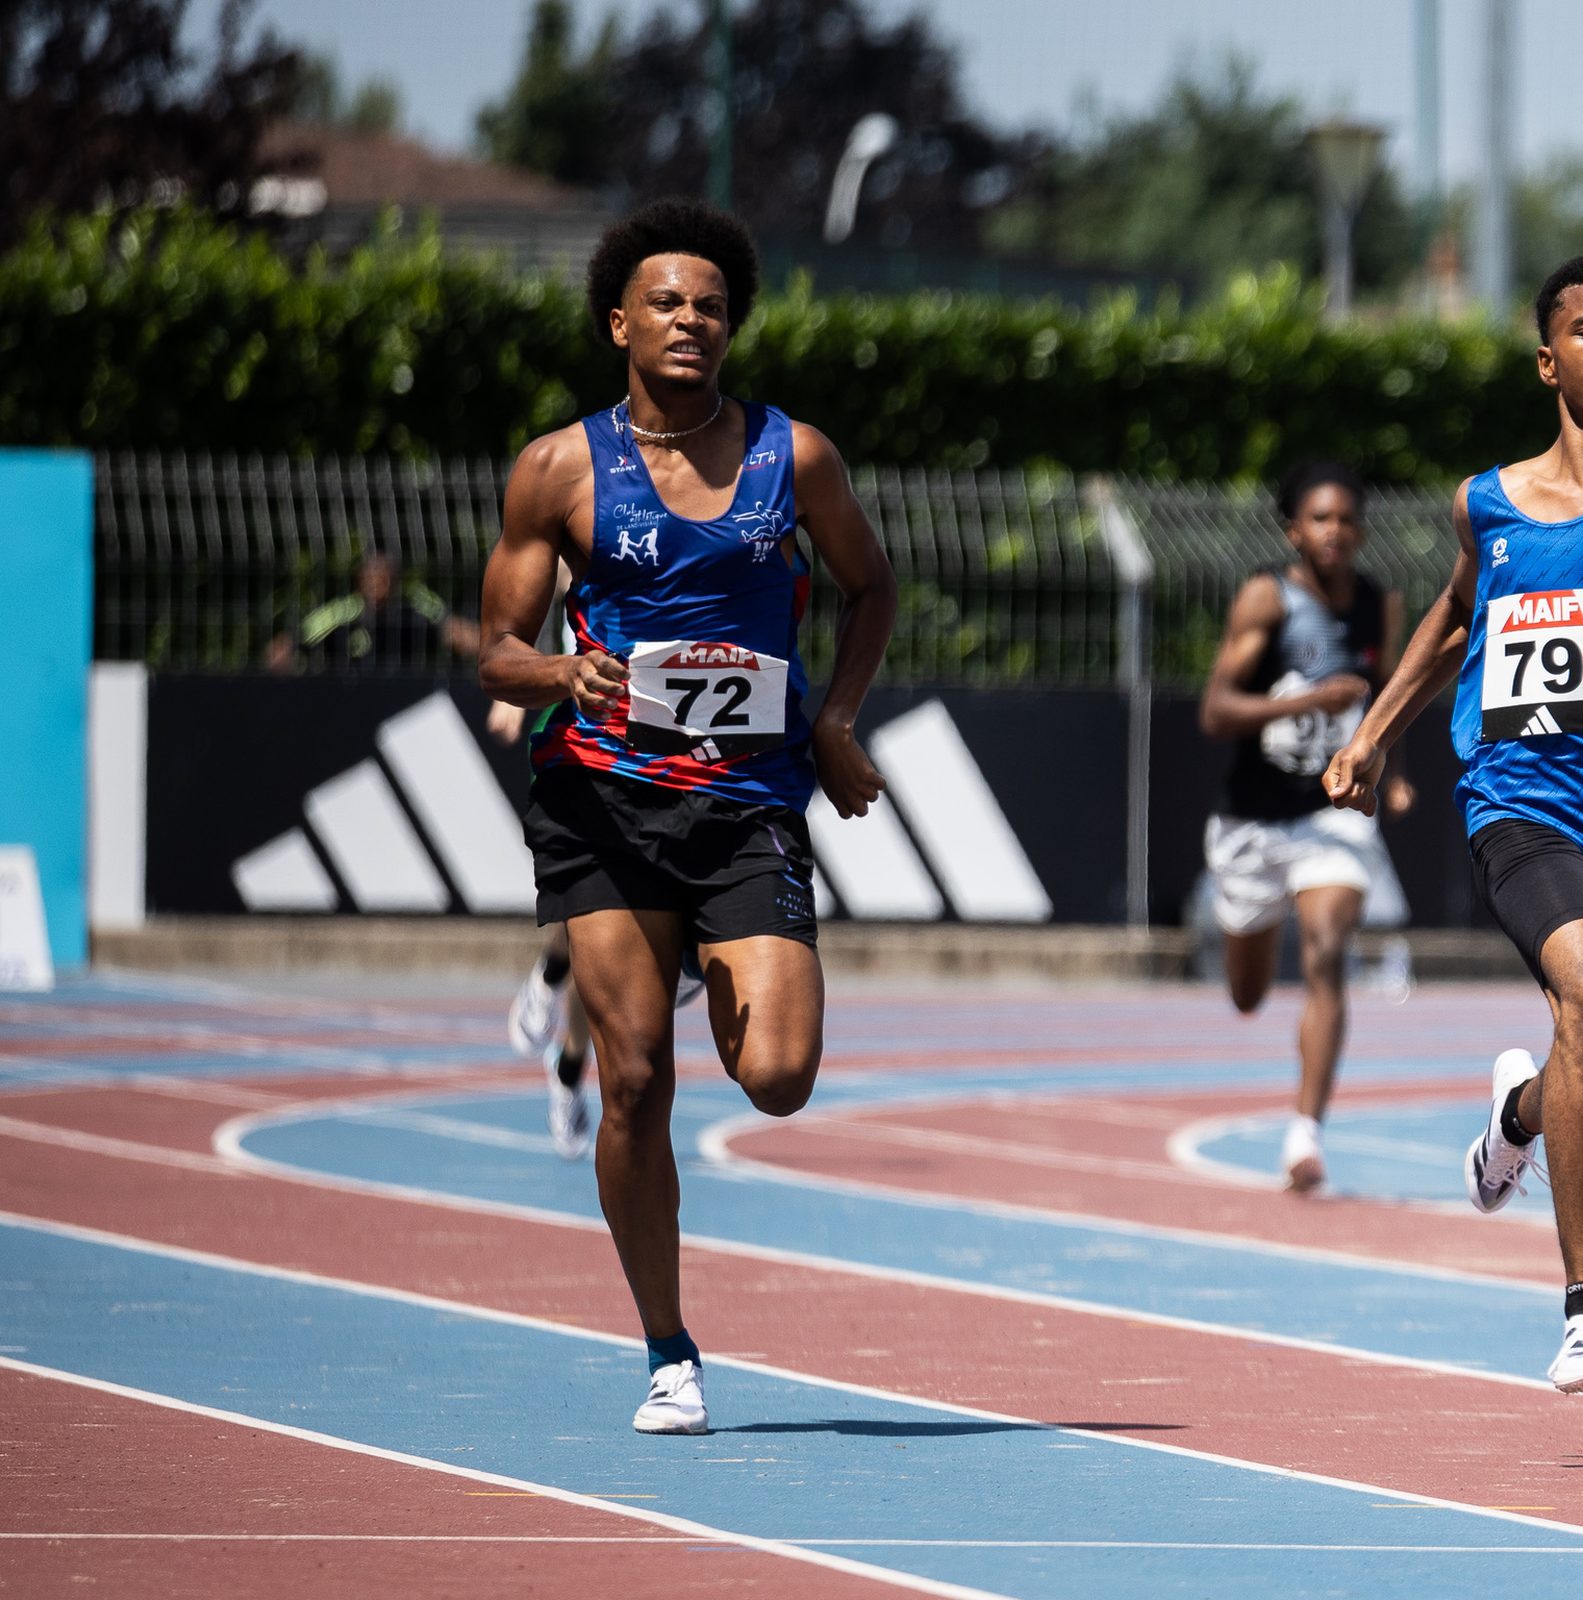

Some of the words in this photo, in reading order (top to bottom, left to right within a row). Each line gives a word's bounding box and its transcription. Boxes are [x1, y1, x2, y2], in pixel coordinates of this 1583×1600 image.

[610, 465, 637, 474] START
[613, 502, 637, 519] Club
[1511, 596, 1579, 626] MAIF
[679, 647, 754, 664] MAIF
[1504, 637, 1583, 698] 79
[665, 675, 752, 728] 72
